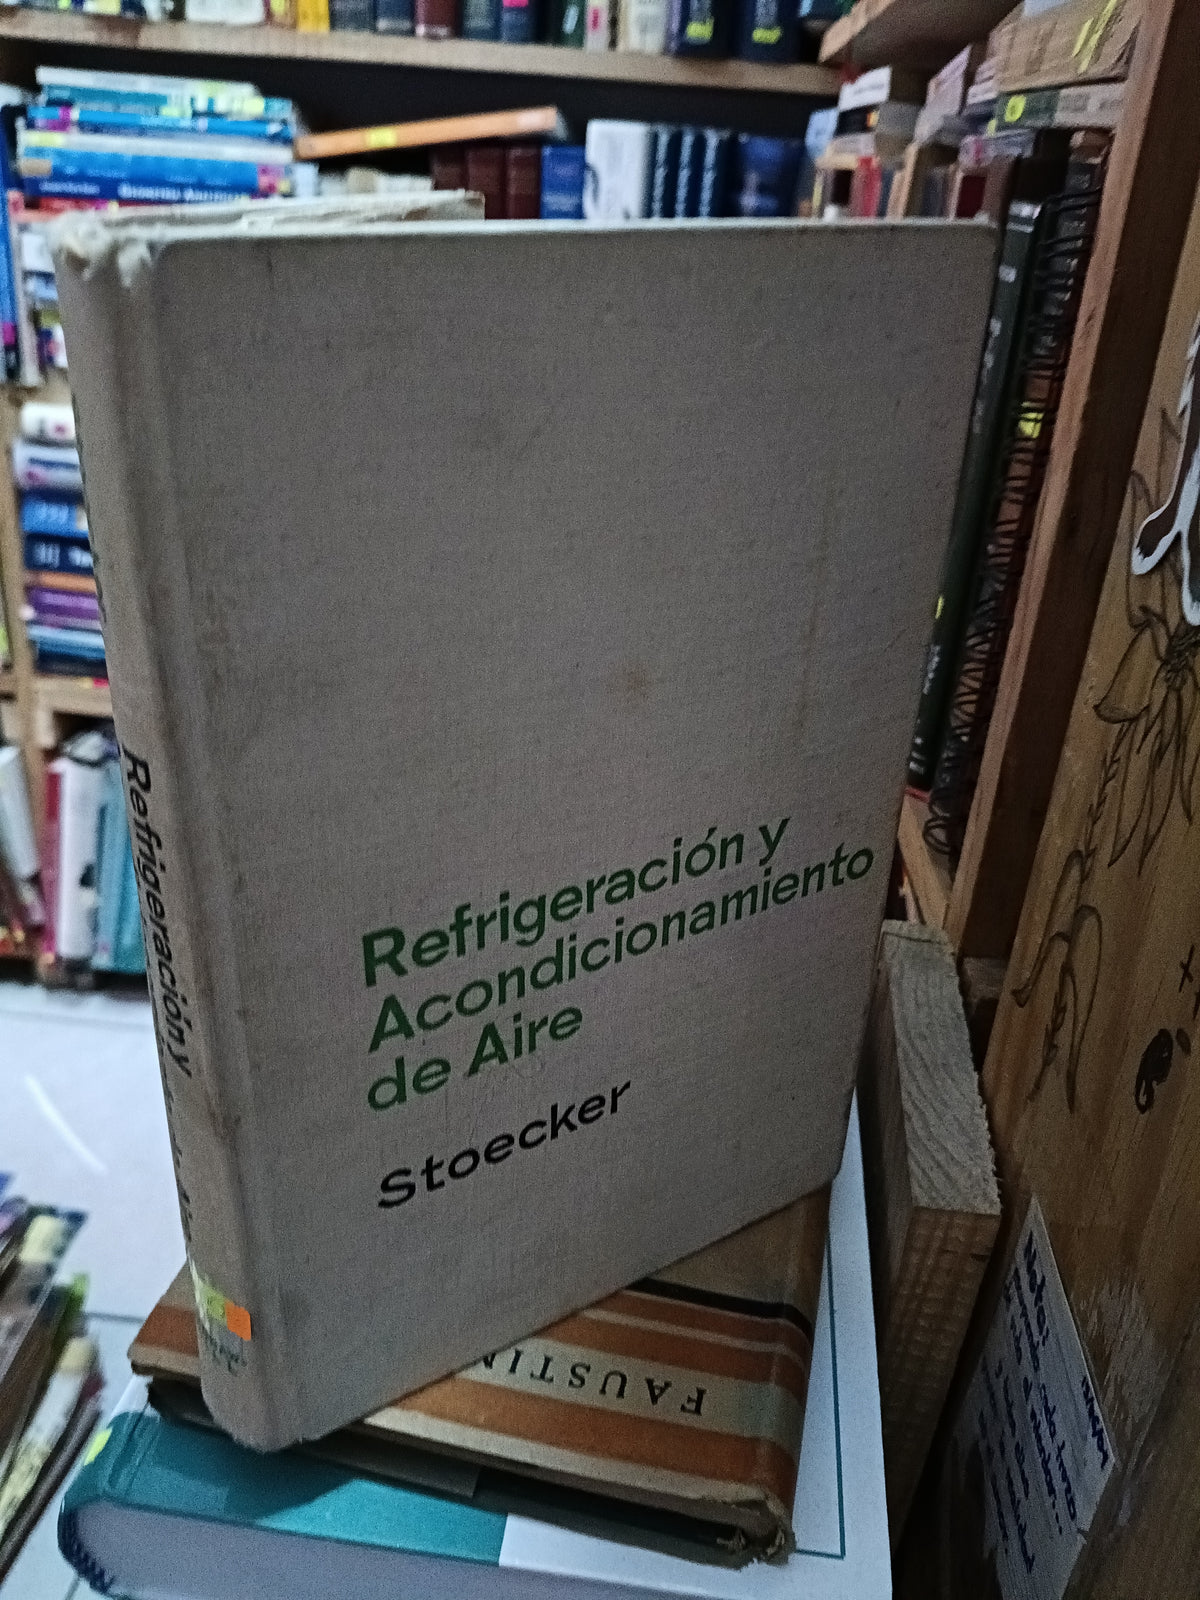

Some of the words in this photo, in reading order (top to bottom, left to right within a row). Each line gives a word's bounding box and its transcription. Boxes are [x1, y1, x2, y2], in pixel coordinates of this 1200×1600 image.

[122, 743, 192, 1045] Refrigeración
[166, 1041, 192, 1078] y
[362, 827, 744, 987] Refrigeración
[758, 817, 790, 864] y
[368, 842, 874, 1053] Acondicionamiento
[367, 1055, 451, 1111] de
[467, 1007, 583, 1077] Aire
[378, 1080, 631, 1208] Stoecker
